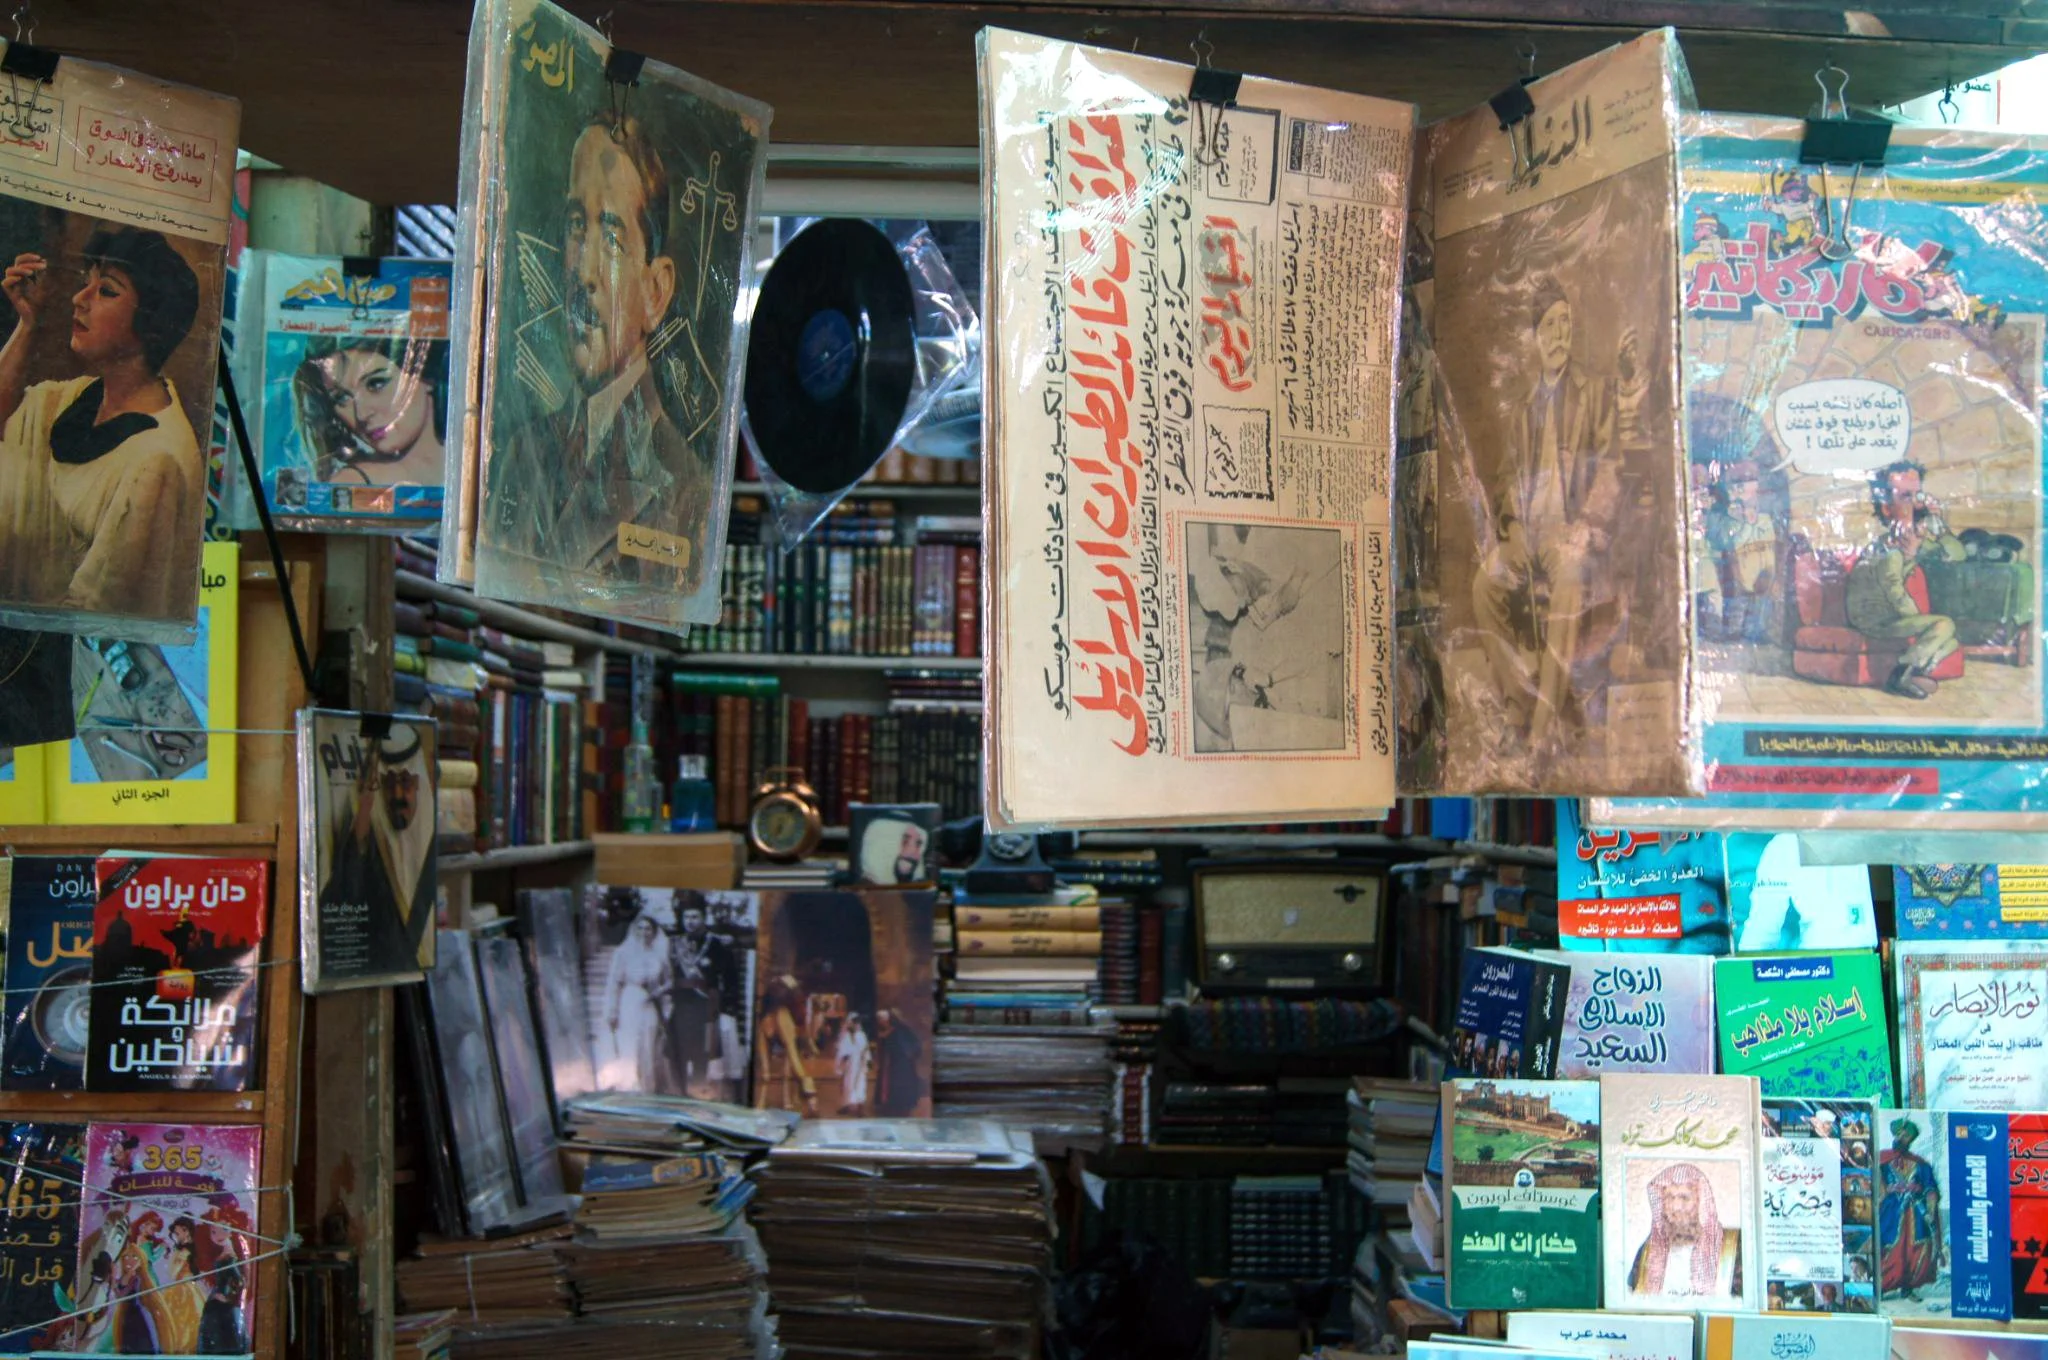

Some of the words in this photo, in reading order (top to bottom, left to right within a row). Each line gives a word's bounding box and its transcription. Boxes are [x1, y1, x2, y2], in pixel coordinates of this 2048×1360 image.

[1160, 220, 1190, 311] معركة
[1202, 214, 1253, 319] أخبار
[1200, 296, 1252, 393] اليوم
[1163, 370, 1193, 420] فوق
[1066, 350, 1142, 539] الطيران
[1043, 501, 1064, 619] محادثات
[1043, 623, 1070, 720] موسكو
[142, 787, 170, 802] الجزء
[124, 876, 195, 909] براون
[200, 877, 246, 909] دان
[1593, 964, 1662, 995] الزواج
[1810, 965, 1831, 978] دكتور
[121, 995, 237, 1030] ملائكة
[1784, 1003, 1814, 1039] بلا
[1813, 984, 1868, 1034] إسلام
[172, 1027, 183, 1043] و
[1576, 1033, 1667, 1067] السعيد
[1731, 1010, 1786, 1057] مذاهب
[110, 1031, 244, 1073] شياطين
[144, 1145, 203, 1172] 365
[1462, 1231, 1506, 1252] الهند
[1510, 1231, 1578, 1259] حضارات
[20, 1258, 65, 1286] قبل
[1559, 1329, 1593, 1342] عرب
[1596, 1330, 1627, 1341] محمد
